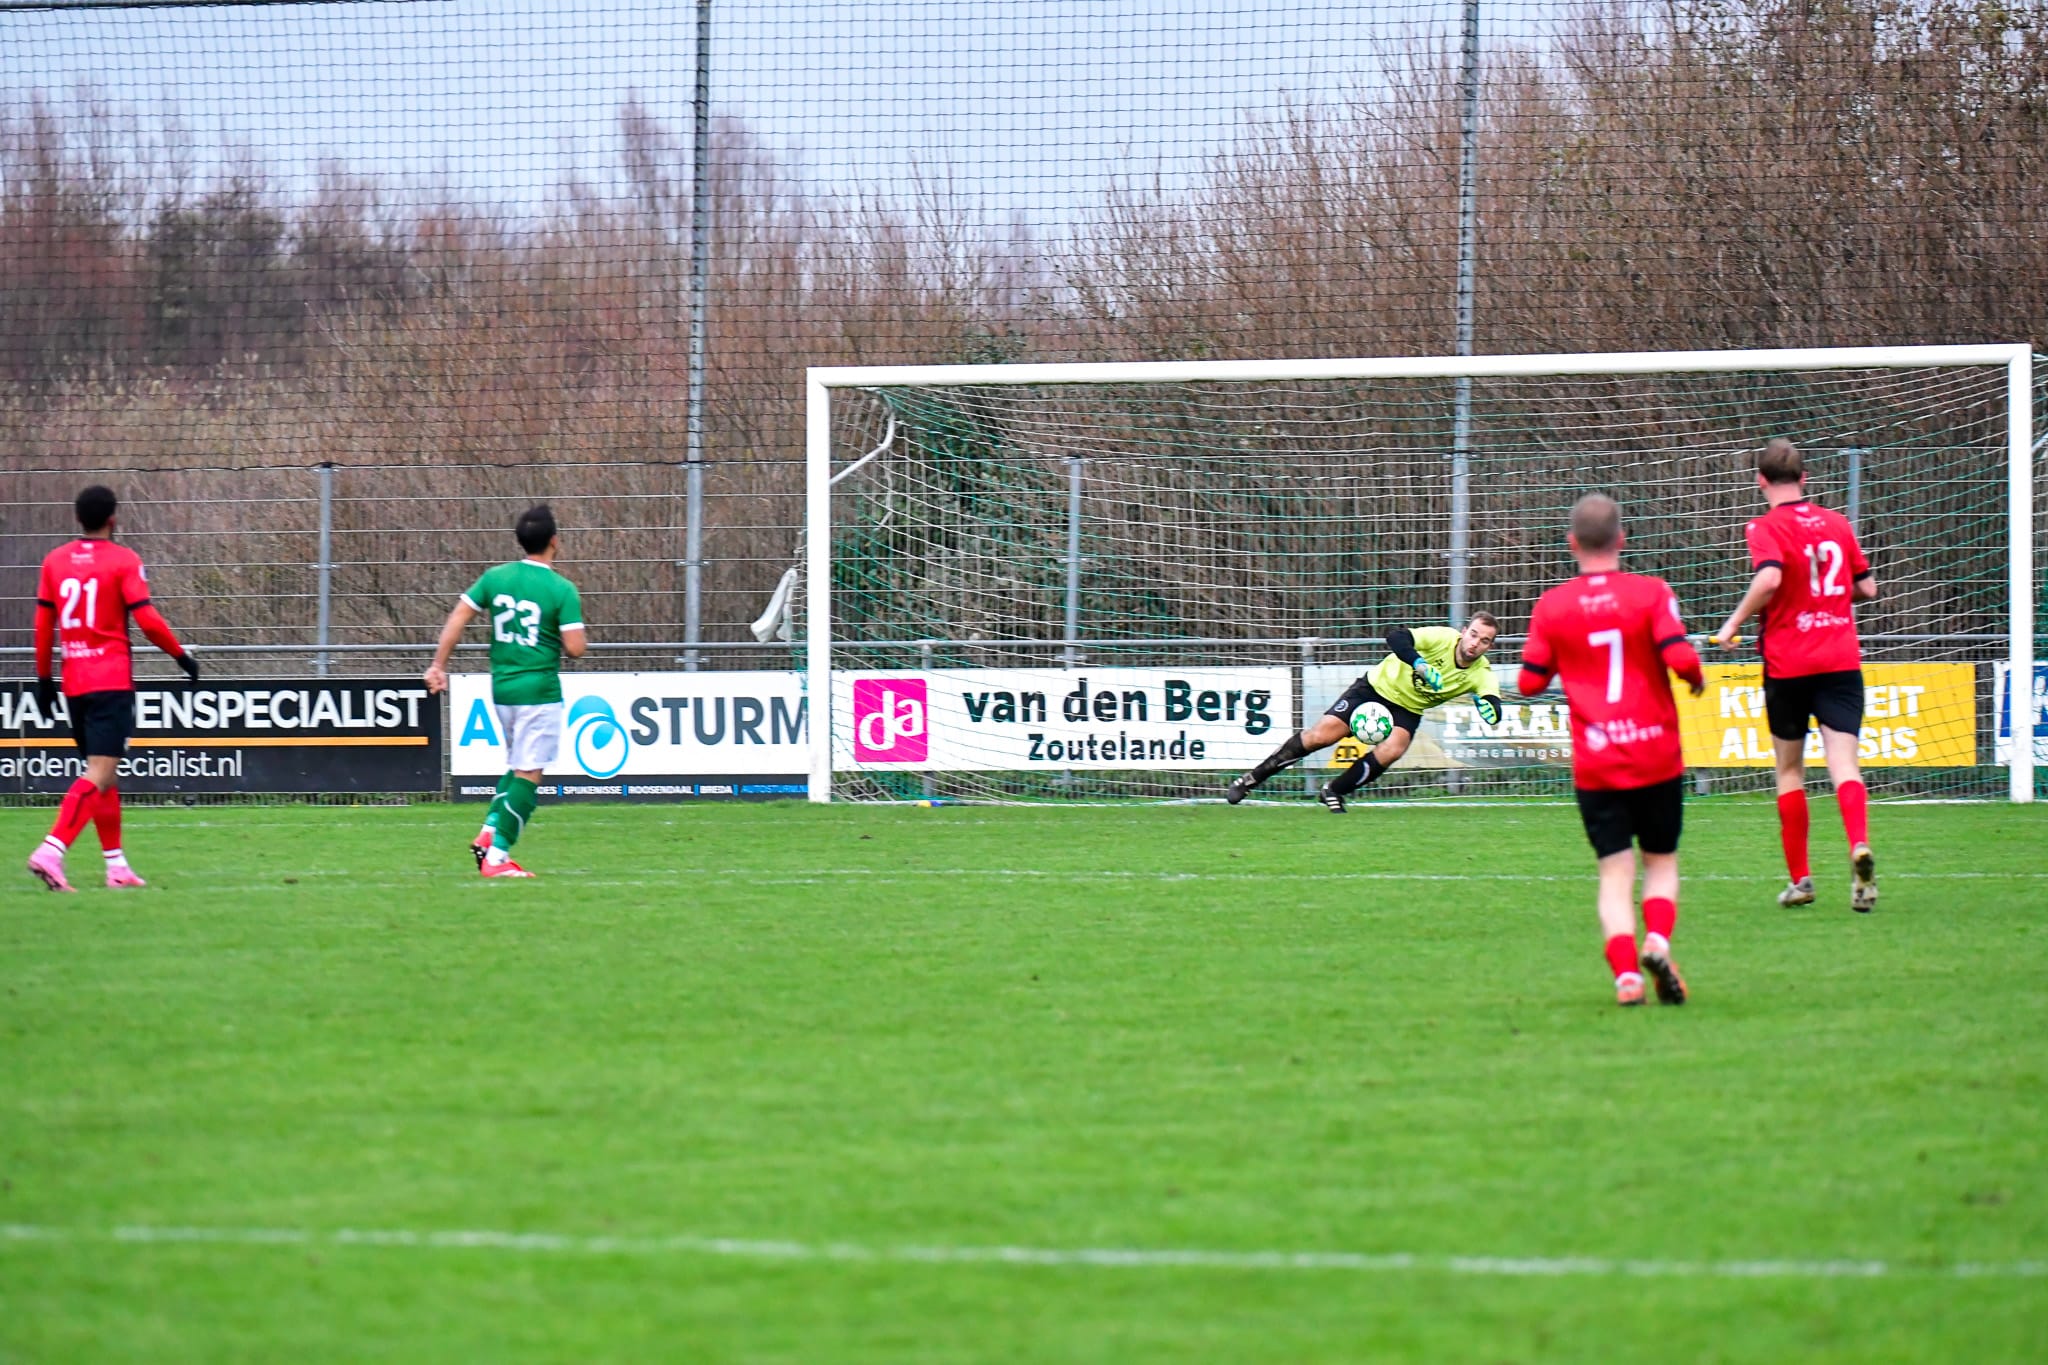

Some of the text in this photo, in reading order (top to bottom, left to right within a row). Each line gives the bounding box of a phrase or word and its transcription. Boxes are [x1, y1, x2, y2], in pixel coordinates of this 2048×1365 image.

[1804, 541, 1845, 597] 12
[59, 577, 98, 629] 21
[492, 594, 542, 647] 23
[1587, 628, 1624, 704] 7
[630, 696, 809, 746] STURM
[858, 690, 924, 751] da
[962, 678, 1271, 736] van den Berg
[1028, 731, 1206, 762] Zoutelande
